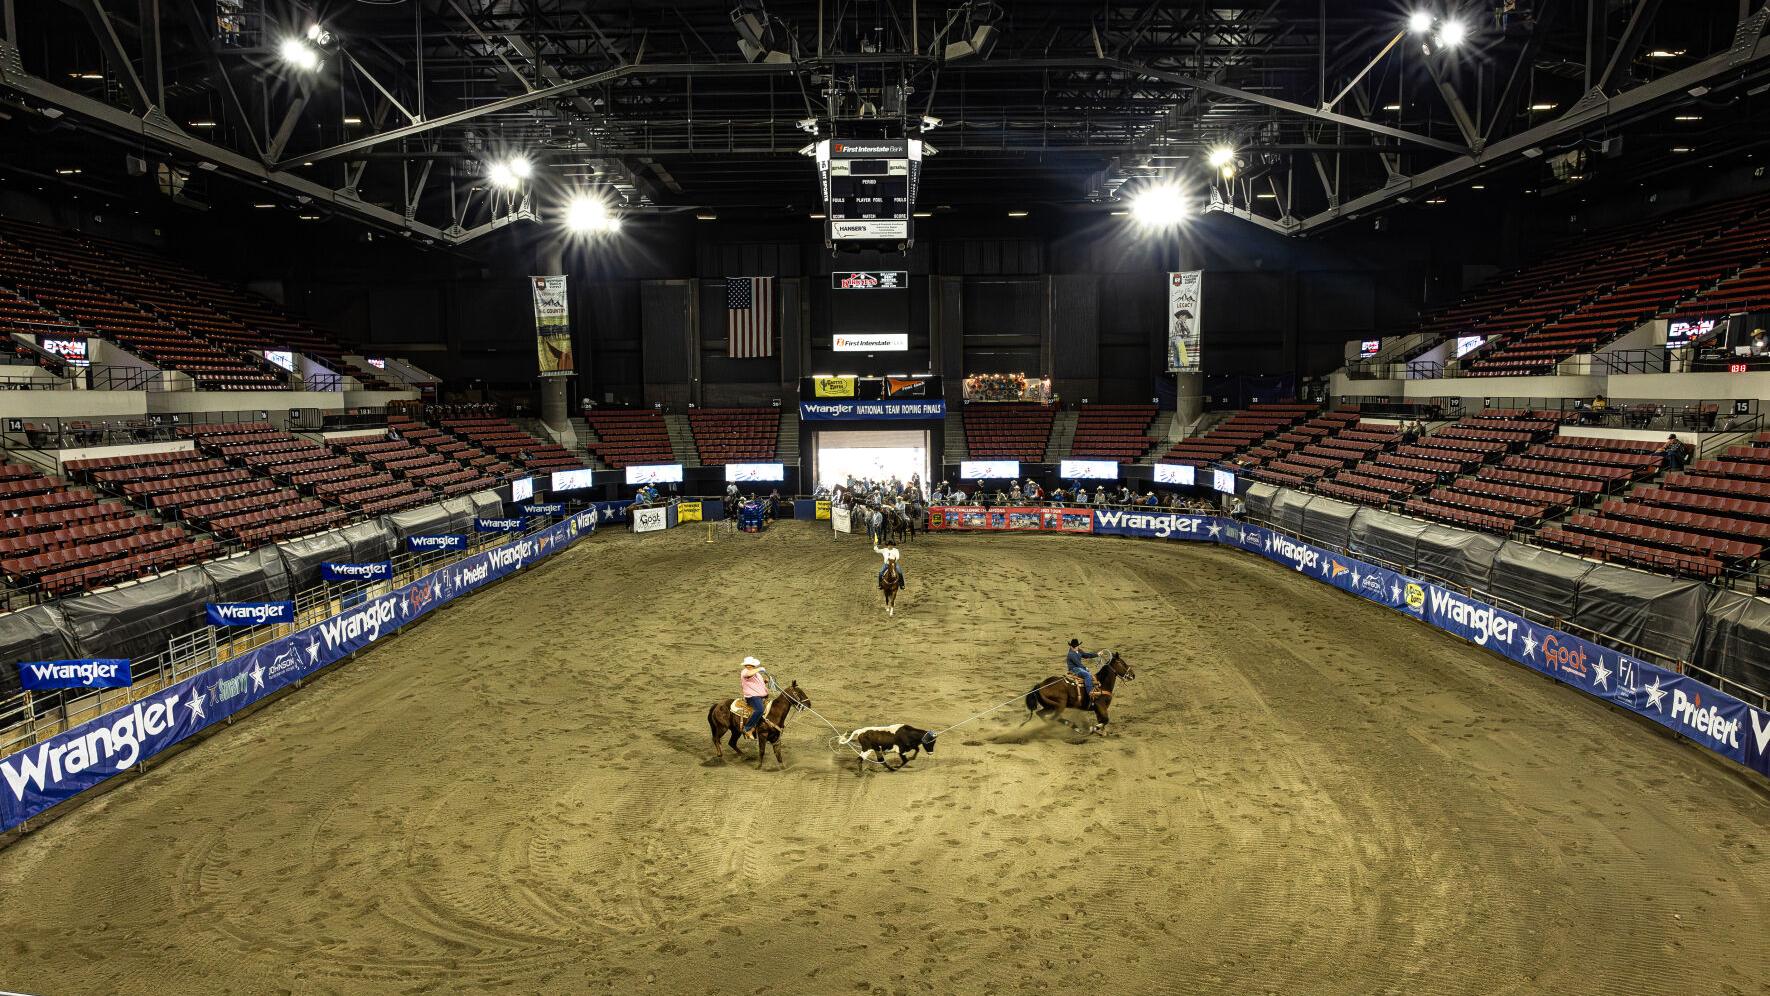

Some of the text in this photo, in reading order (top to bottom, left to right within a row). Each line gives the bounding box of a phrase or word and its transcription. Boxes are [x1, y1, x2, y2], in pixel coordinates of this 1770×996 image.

[291, 410, 299, 418] 18
[805, 404, 941, 416] Wrangler NATIONAL TEAM ROPING FINALS
[1736, 402, 1748, 411] 15
[10, 421, 21, 430] 14
[524, 504, 561, 515] Wrangler
[480, 519, 521, 531] Wrangler
[1095, 510, 1202, 537] Wrangler
[411, 535, 460, 549] Wrangler
[1272, 533, 1320, 571] Wrangler
[488, 540, 532, 570] Wrangler
[331, 562, 388, 579] Wrangler
[216, 603, 285, 623] Wrangler
[319, 598, 397, 642] Wrangler
[1430, 586, 1518, 645] Wrangler
[1542, 634, 1587, 672] Goat
[30, 663, 118, 685] Wrangler
[1671, 688, 1739, 749] Priefert
[0, 694, 180, 802] Wrangler
